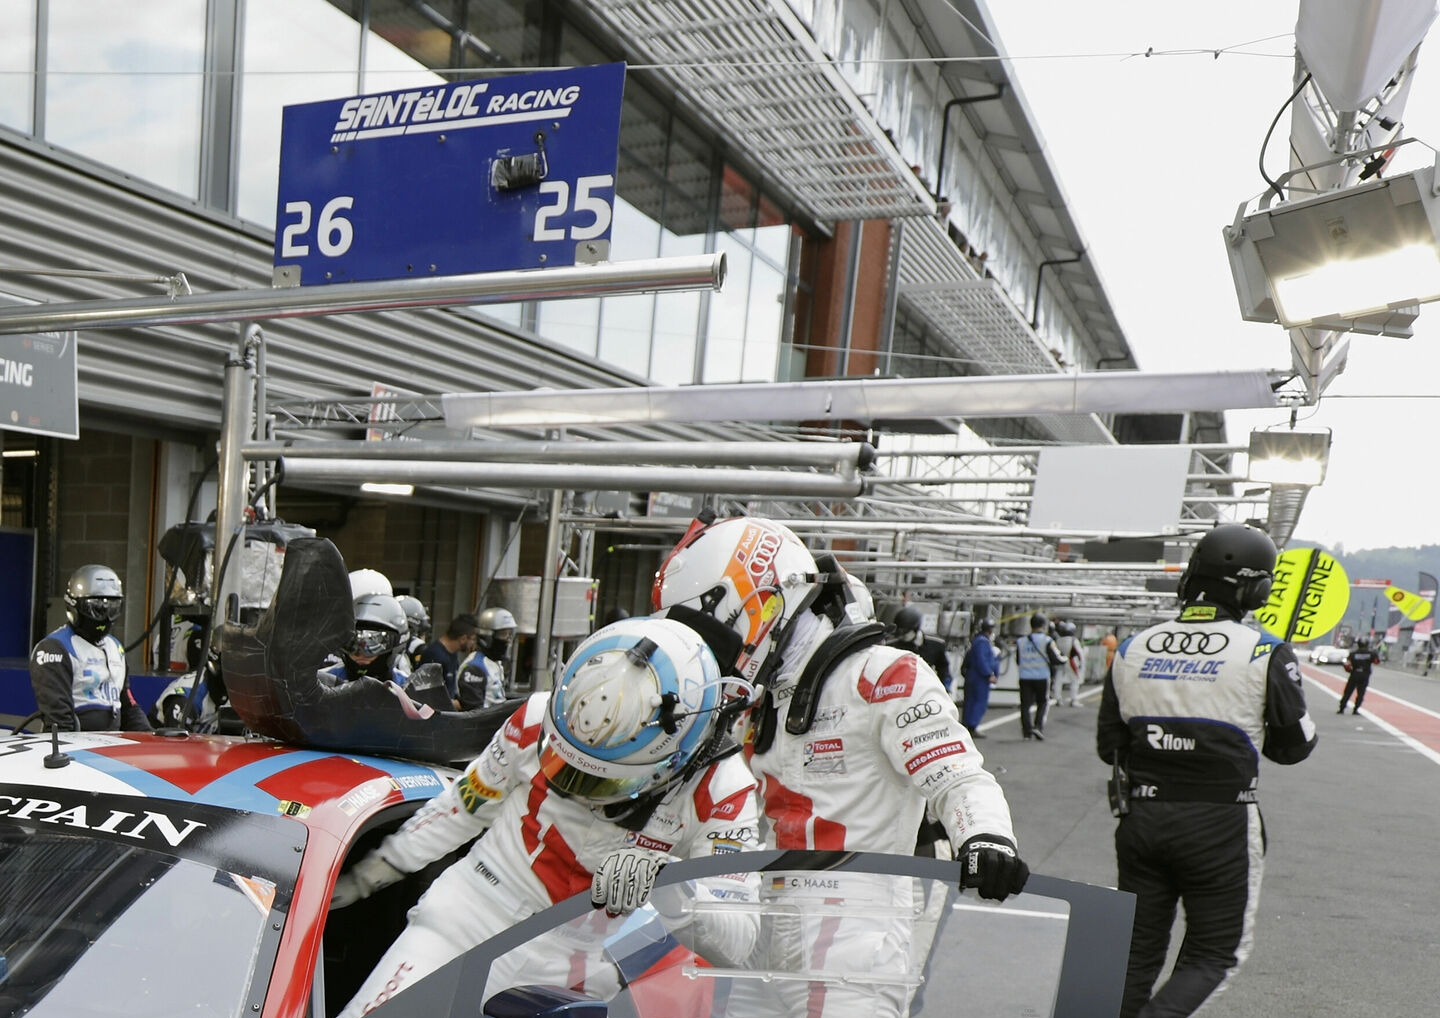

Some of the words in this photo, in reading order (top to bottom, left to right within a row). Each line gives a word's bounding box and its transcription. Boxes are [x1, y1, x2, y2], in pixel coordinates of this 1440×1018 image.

[486, 85, 581, 114] RACING
[281, 197, 354, 257] 26
[533, 175, 613, 242] 25
[742, 528, 757, 549] Audi
[1261, 555, 1295, 627] START
[1295, 558, 1334, 638] ENGINE
[556, 741, 575, 760] Audi
[577, 757, 608, 773] Sport
[814, 742, 841, 751] TOTAL
[639, 836, 669, 850] TOTAL
[791, 879, 801, 889] C.
[804, 879, 840, 889] HAASE
